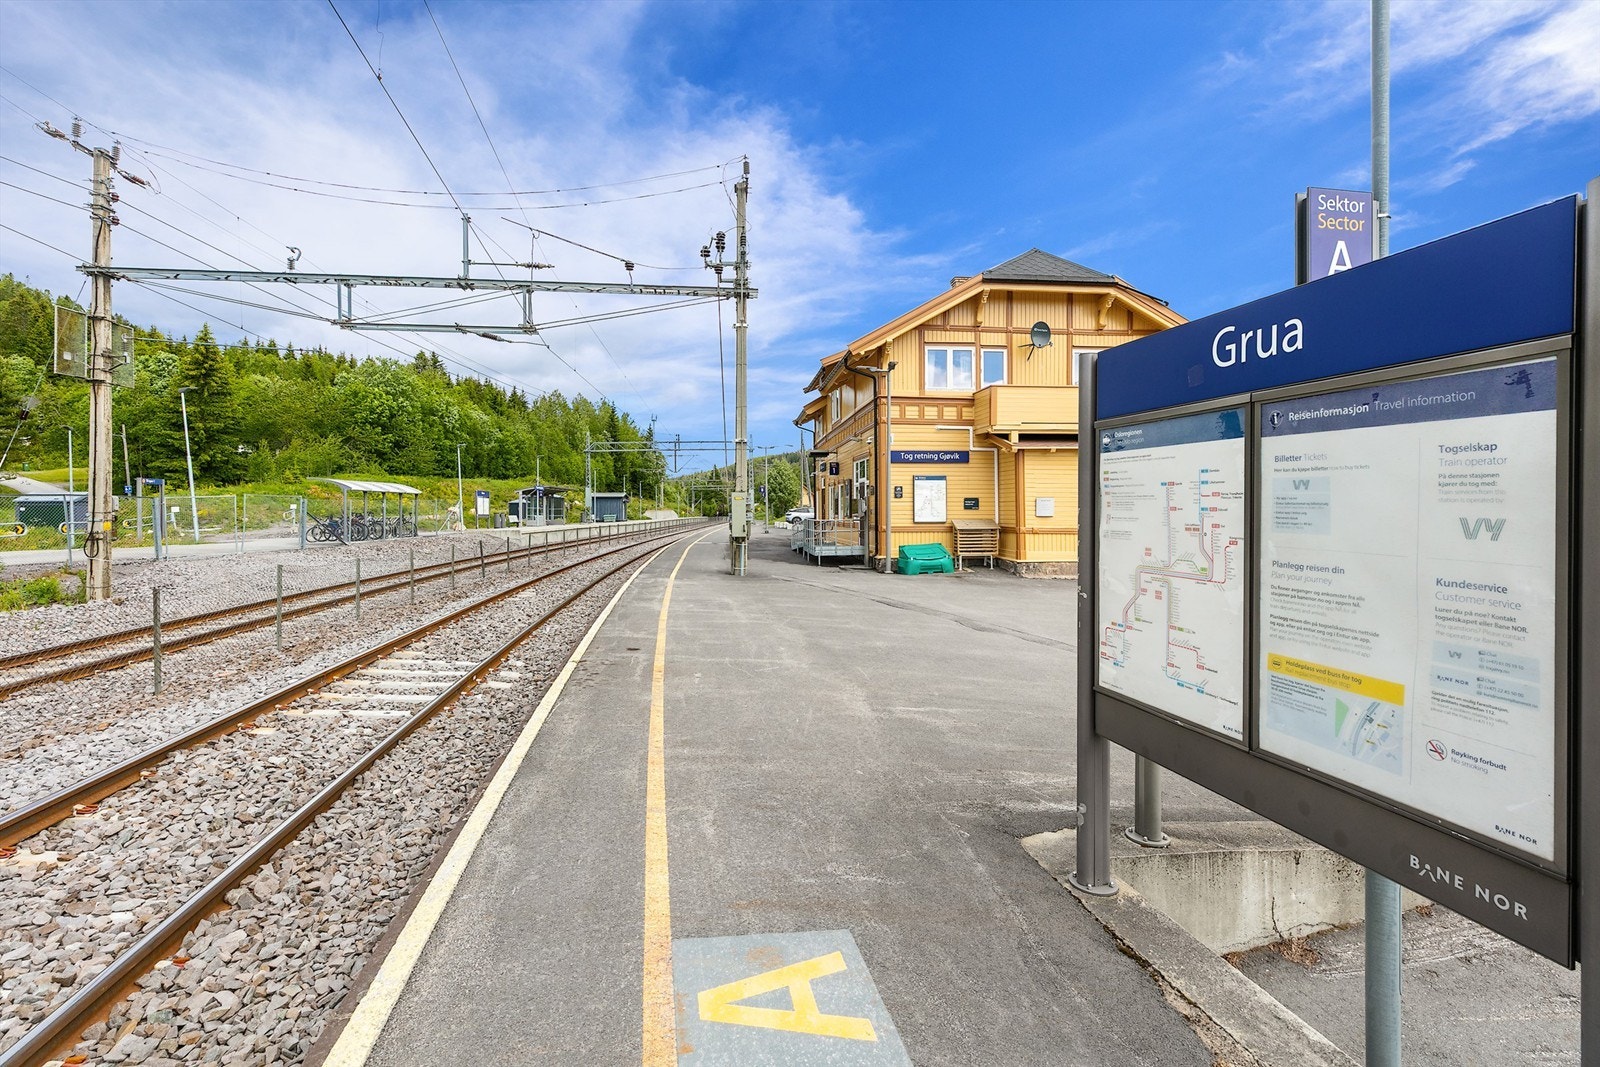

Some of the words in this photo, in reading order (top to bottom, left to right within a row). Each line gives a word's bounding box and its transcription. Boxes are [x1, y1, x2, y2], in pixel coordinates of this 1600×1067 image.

[1318, 194, 1365, 213] Sektor
[1318, 213, 1364, 232] Sector
[1328, 240, 1352, 276] A
[1212, 318, 1304, 368] Grua
[1288, 404, 1369, 422] Reiseinformasjon
[1373, 398, 1404, 411] Travel
[1408, 391, 1476, 408] information
[900, 452, 913, 461] Tog
[914, 452, 938, 461] retning
[940, 452, 960, 460] Gjøvik
[1274, 454, 1302, 463] Billetter
[1303, 452, 1328, 461] Tickets
[1438, 442, 1498, 455] Togselskap
[1440, 458, 1462, 467] Train
[1465, 456, 1508, 468] operator
[1272, 560, 1304, 572] Planlegg
[1306, 563, 1329, 573] reisen
[1331, 566, 1345, 574] din
[1271, 571, 1285, 579] Plan
[1286, 573, 1302, 581] your
[1303, 575, 1333, 586] journey
[1436, 578, 1508, 594] Kundeservice
[1435, 591, 1485, 605] Customer
[1488, 598, 1522, 610] service
[1434, 614, 1478, 626] togselskapet
[1511, 626, 1529, 634] NOR.
[1491, 614, 1516, 623] Kontakt
[1286, 660, 1315, 672] Holdeplass
[1316, 667, 1326, 675] ved
[1327, 669, 1341, 678] buss
[1352, 676, 1363, 685] tog
[1451, 748, 1478, 763] Røyking
[1479, 757, 1507, 771] forbudt
[1451, 756, 1460, 764] No
[1461, 761, 1488, 774] smoking
[1495, 825, 1515, 836] BANE
[1519, 834, 1537, 845] NOR
[1410, 854, 1464, 890] BANE
[1475, 884, 1528, 921] NOR
[698, 951, 878, 1042] A
